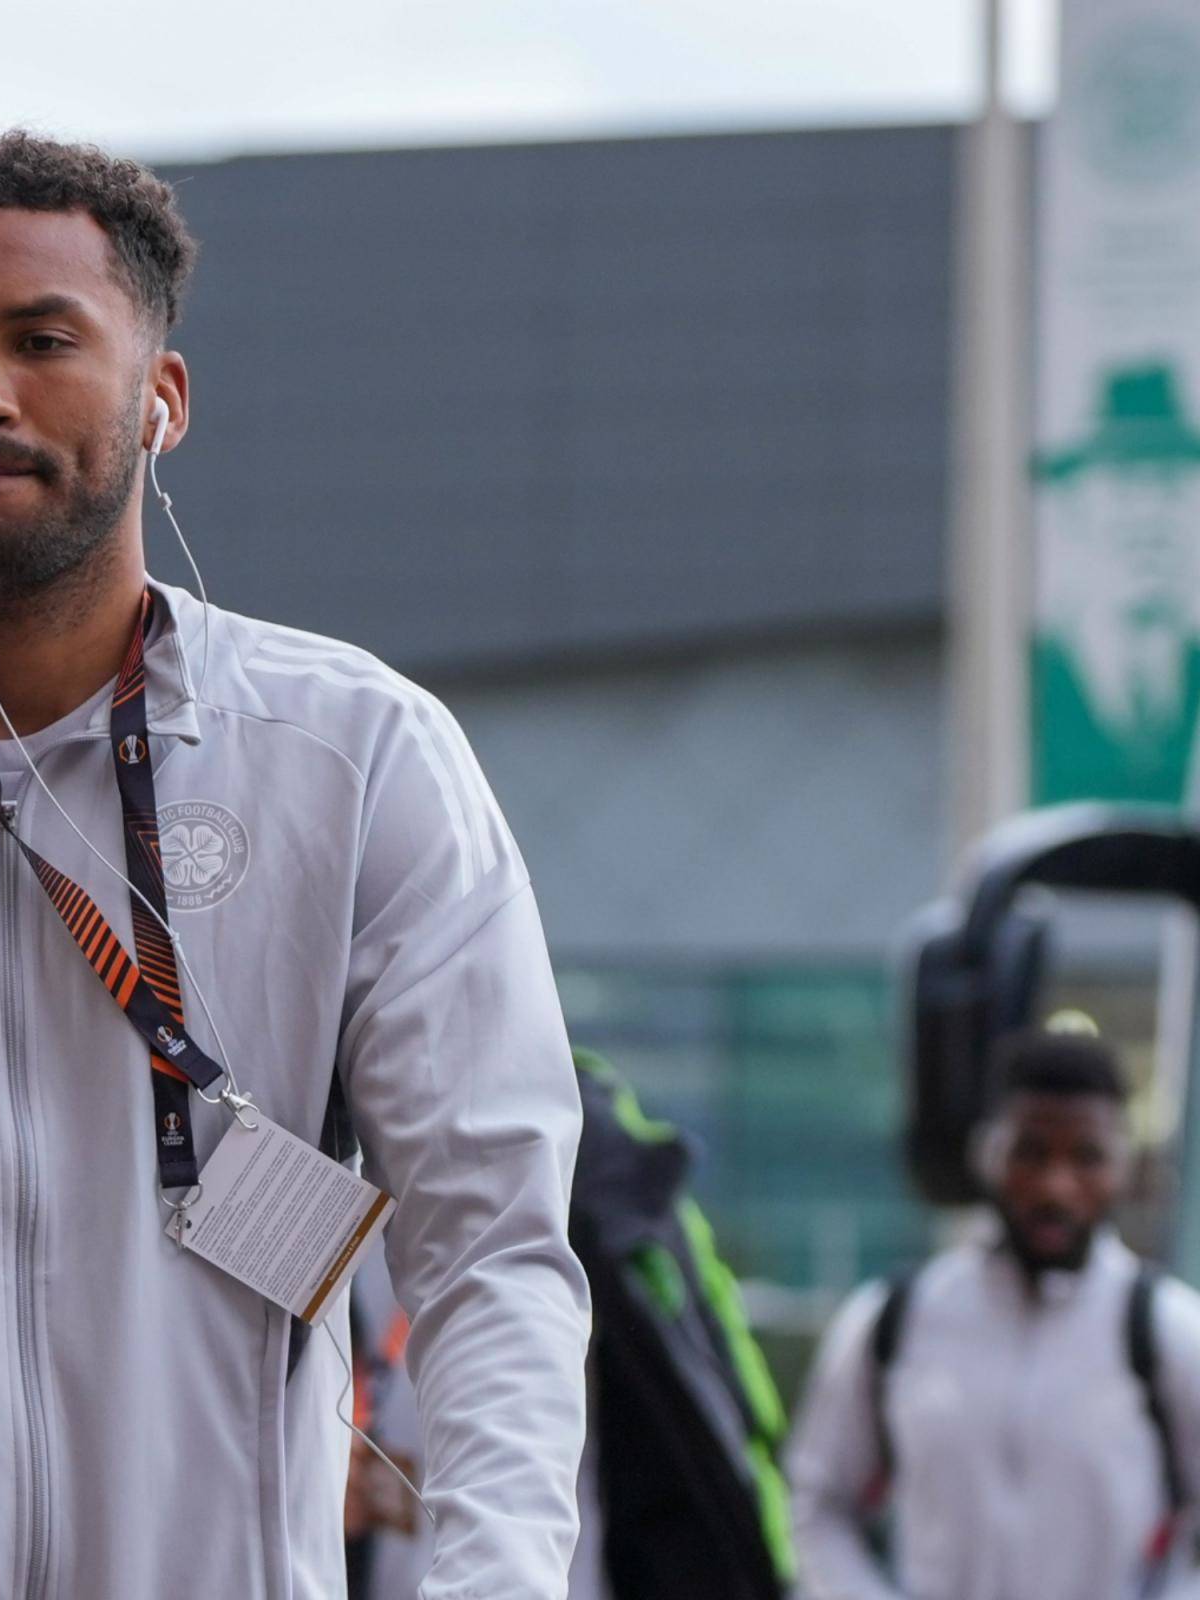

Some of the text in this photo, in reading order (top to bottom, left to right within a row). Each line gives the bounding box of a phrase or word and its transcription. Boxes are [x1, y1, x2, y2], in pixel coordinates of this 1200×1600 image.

[177, 804, 230, 829] FOOTBALL
[228, 825, 245, 854] CLUB
[177, 895, 203, 906] 1888
